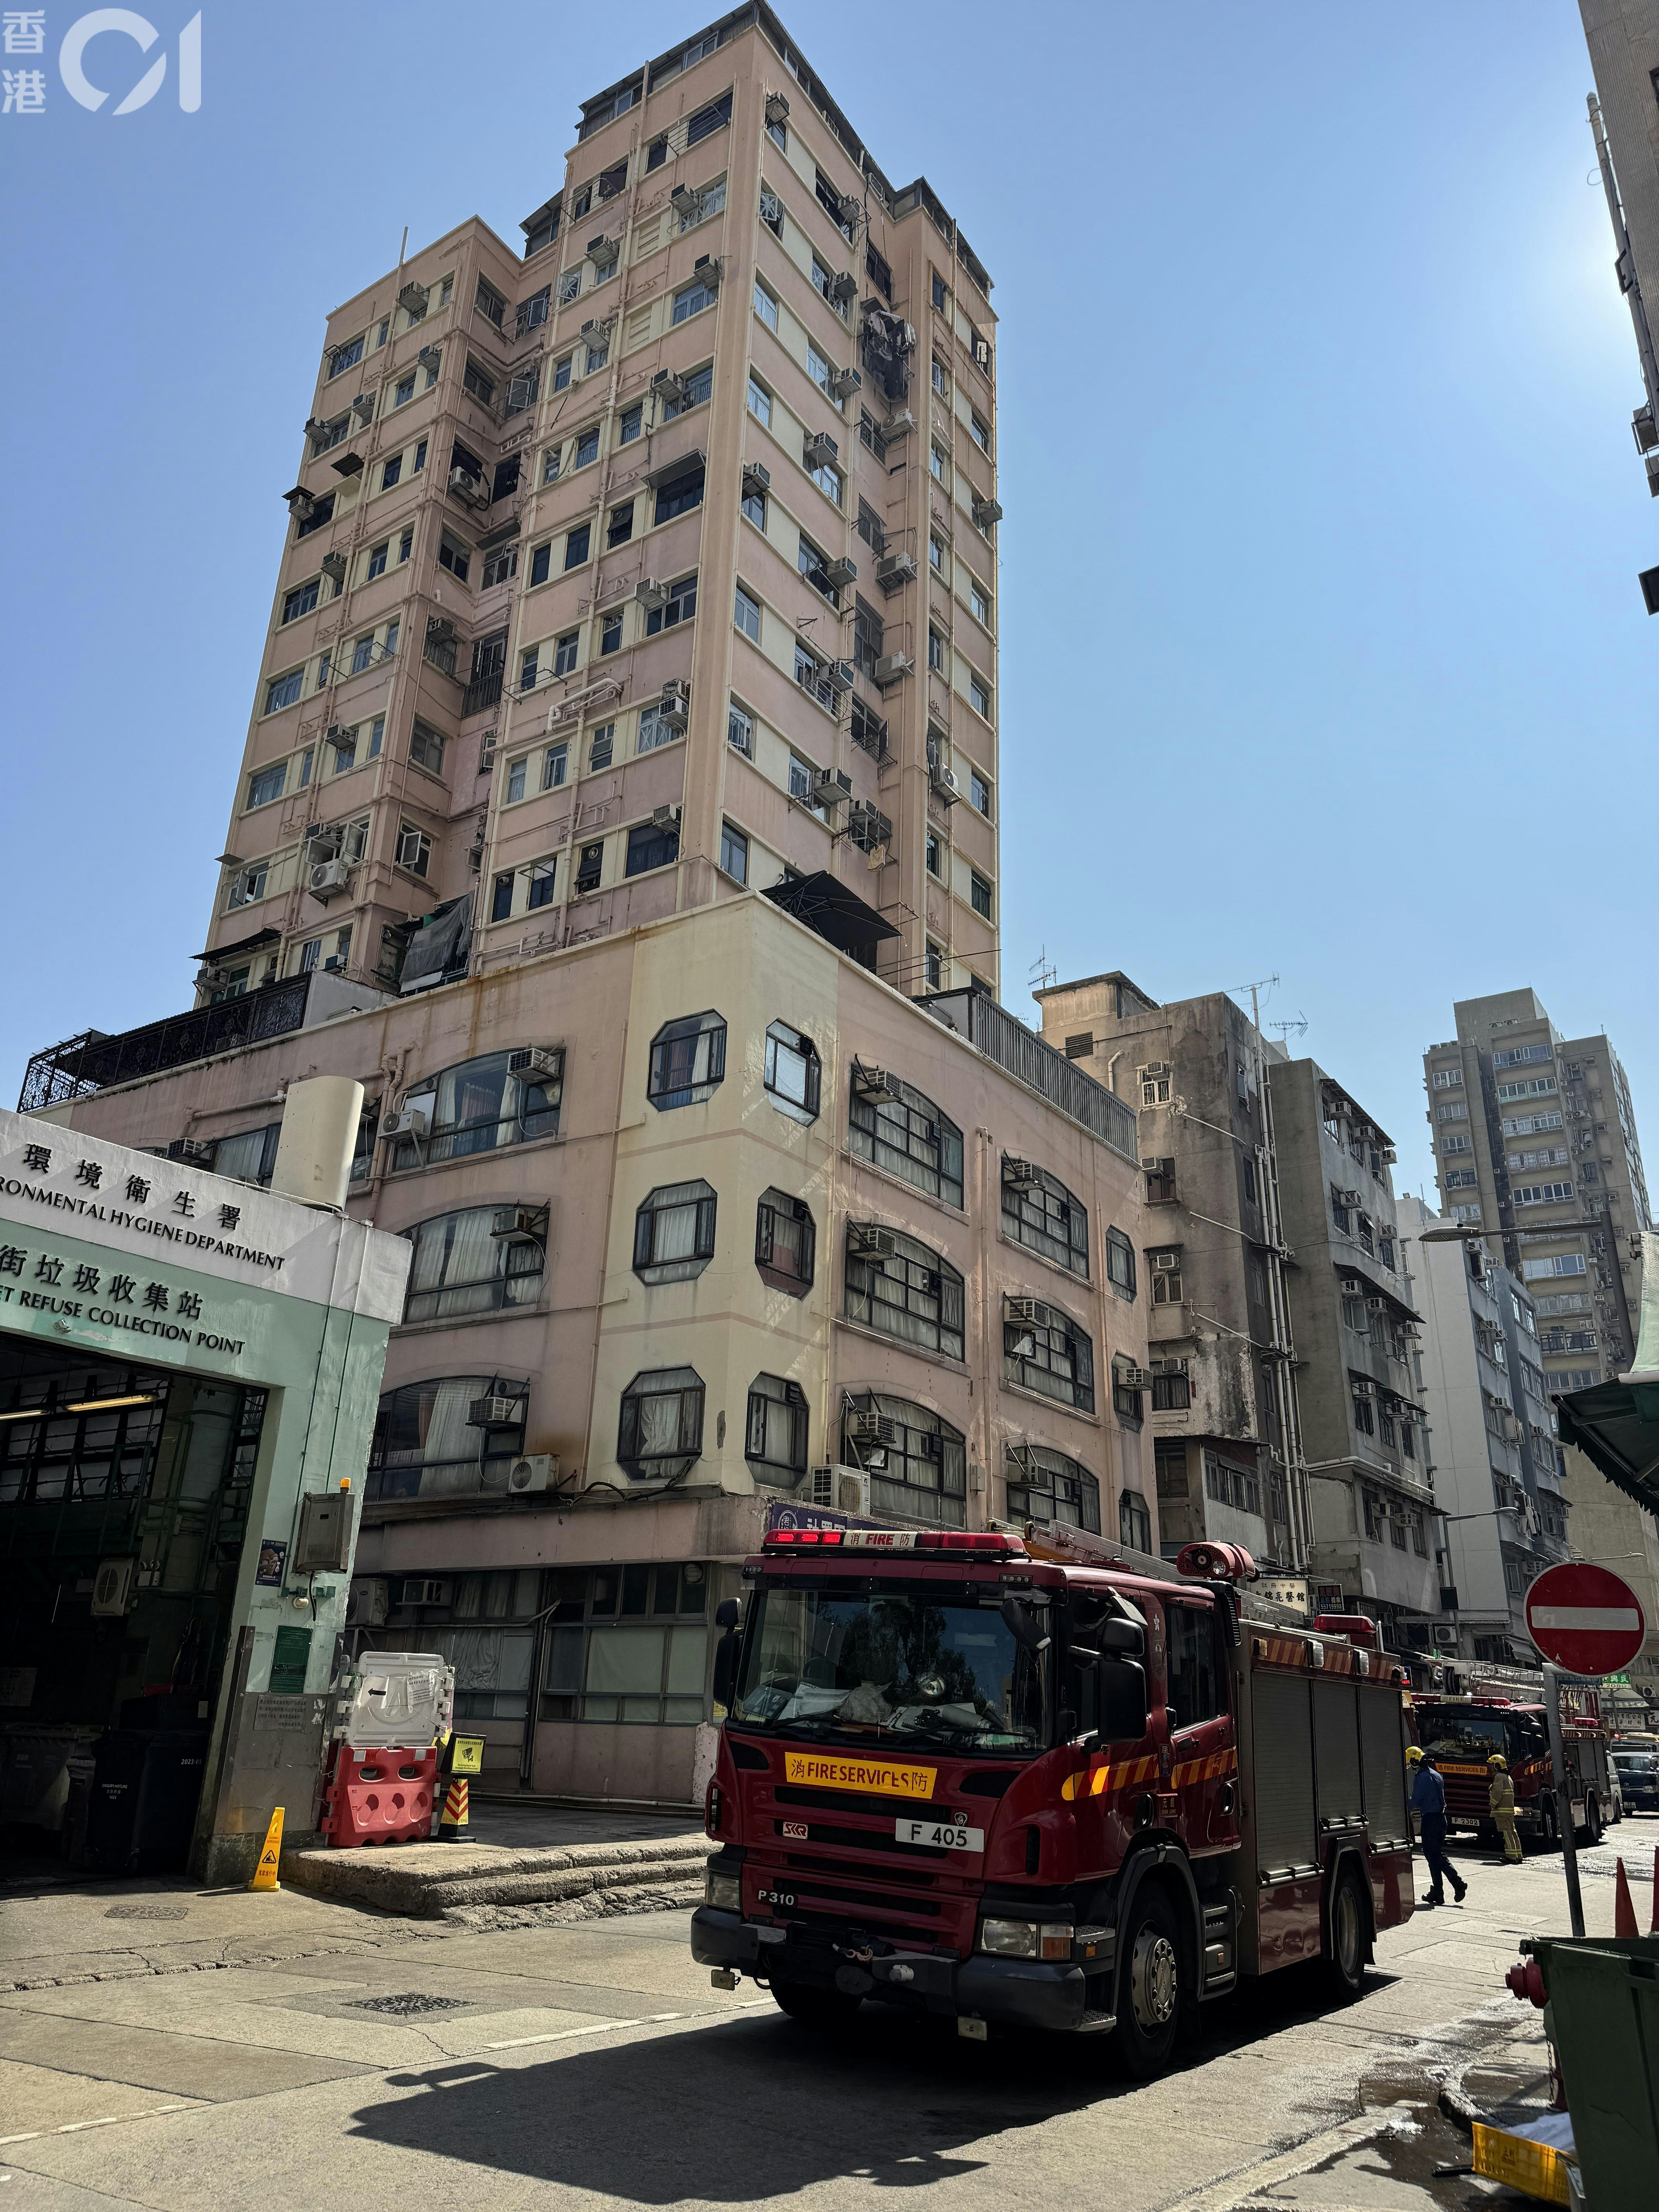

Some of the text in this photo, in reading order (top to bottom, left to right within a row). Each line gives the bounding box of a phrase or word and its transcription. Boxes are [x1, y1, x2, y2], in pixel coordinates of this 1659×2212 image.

[23, 1143, 241, 1230] 環境衛生署
[110, 1209, 184, 1242] HYGIENE
[185, 1231, 285, 1270] DEPARTMENT
[0, 1244, 203, 1320] 街垃圾收集站
[19, 1290, 83, 1317] REFUSE
[88, 1307, 192, 1343] COLLECTION
[197, 1332, 246, 1354] POINT
[851, 1533, 910, 1546] 消 FIRE 防
[791, 1759, 805, 1778] 消
[807, 1762, 838, 1780] FIRE
[912, 1771, 928, 1792] 防
[911, 1824, 967, 1847] F 405
[758, 1890, 794, 1905] P 310
